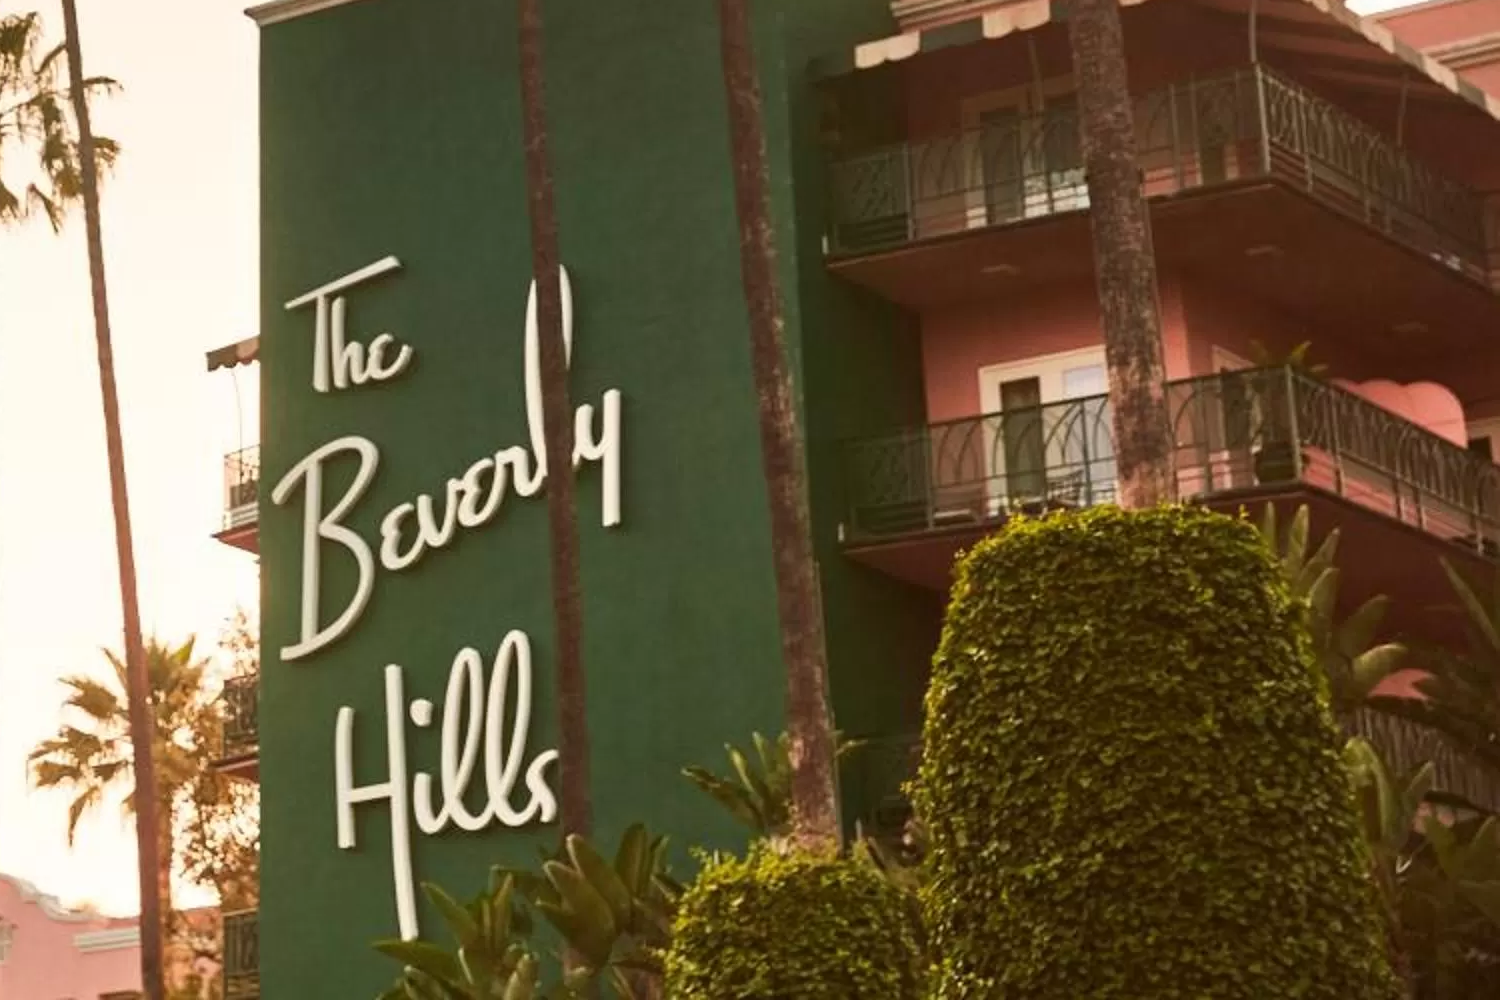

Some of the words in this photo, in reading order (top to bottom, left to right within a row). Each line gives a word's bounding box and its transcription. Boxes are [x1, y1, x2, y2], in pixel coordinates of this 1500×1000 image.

[271, 263, 621, 661] Beverly
[285, 255, 413, 392] The
[336, 629, 559, 942] Hills
